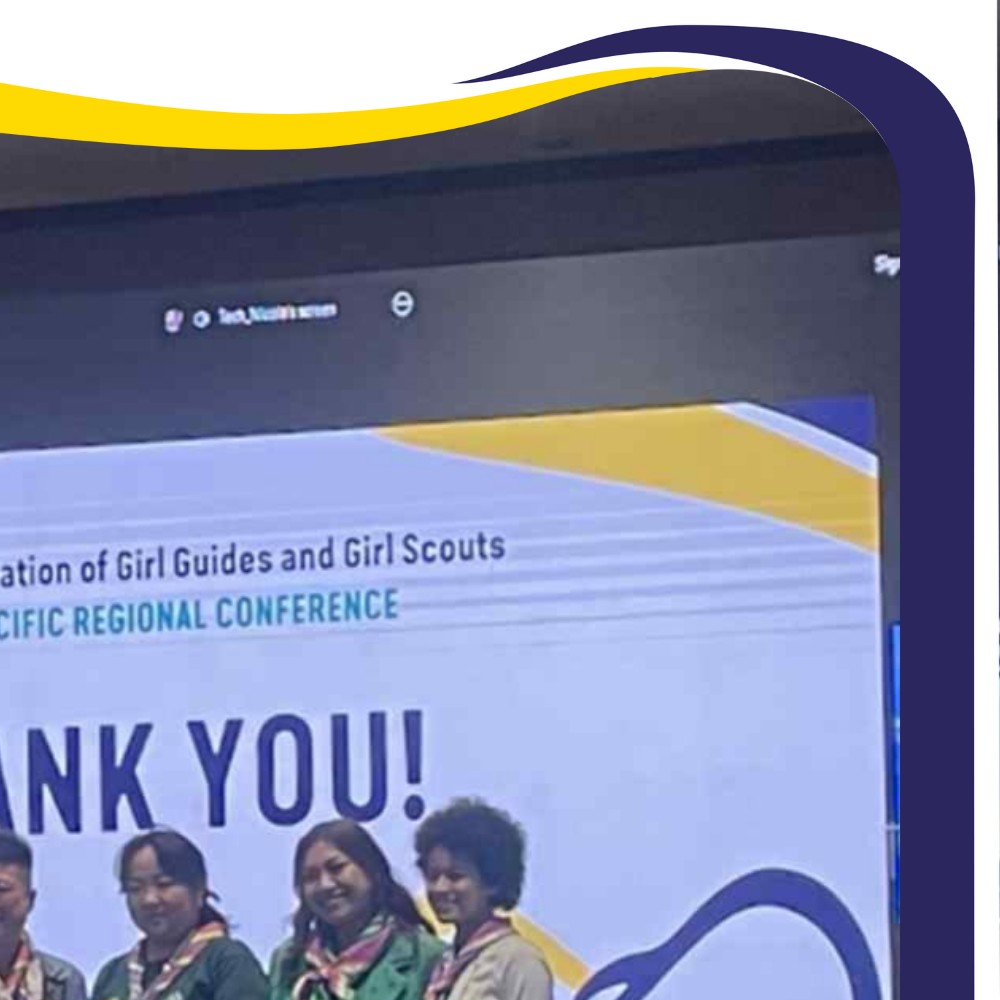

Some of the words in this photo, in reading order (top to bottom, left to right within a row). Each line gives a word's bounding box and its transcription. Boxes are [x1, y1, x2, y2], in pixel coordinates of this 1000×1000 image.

[80, 549, 108, 583] of
[116, 546, 165, 581] Girl
[173, 542, 273, 577] Guides
[281, 537, 335, 571] and
[343, 532, 394, 568] Girl
[402, 531, 506, 565] Scouts
[73, 598, 207, 637] REGIONAL
[216, 587, 399, 629] CONFERENCE
[186, 708, 426, 828] YOU!
